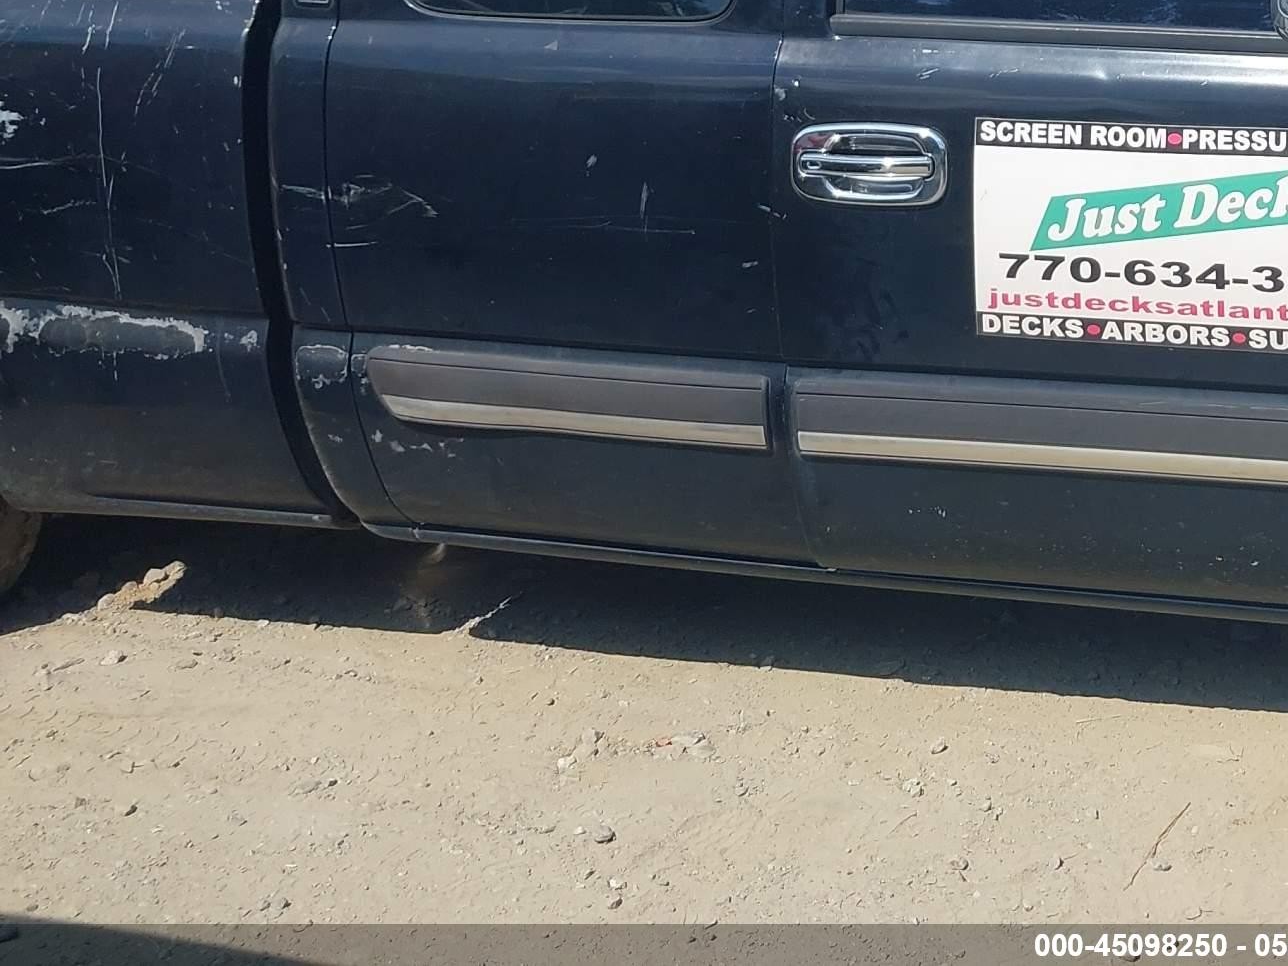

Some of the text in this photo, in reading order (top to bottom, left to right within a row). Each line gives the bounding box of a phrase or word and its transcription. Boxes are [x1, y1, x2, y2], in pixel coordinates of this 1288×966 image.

[980, 120, 1083, 146] SCREEN
[1090, 125, 1167, 149] ROOM
[1047, 193, 1167, 242] Just
[981, 313, 1085, 339] DECKS
[1101, 321, 1231, 347] ARBORS
